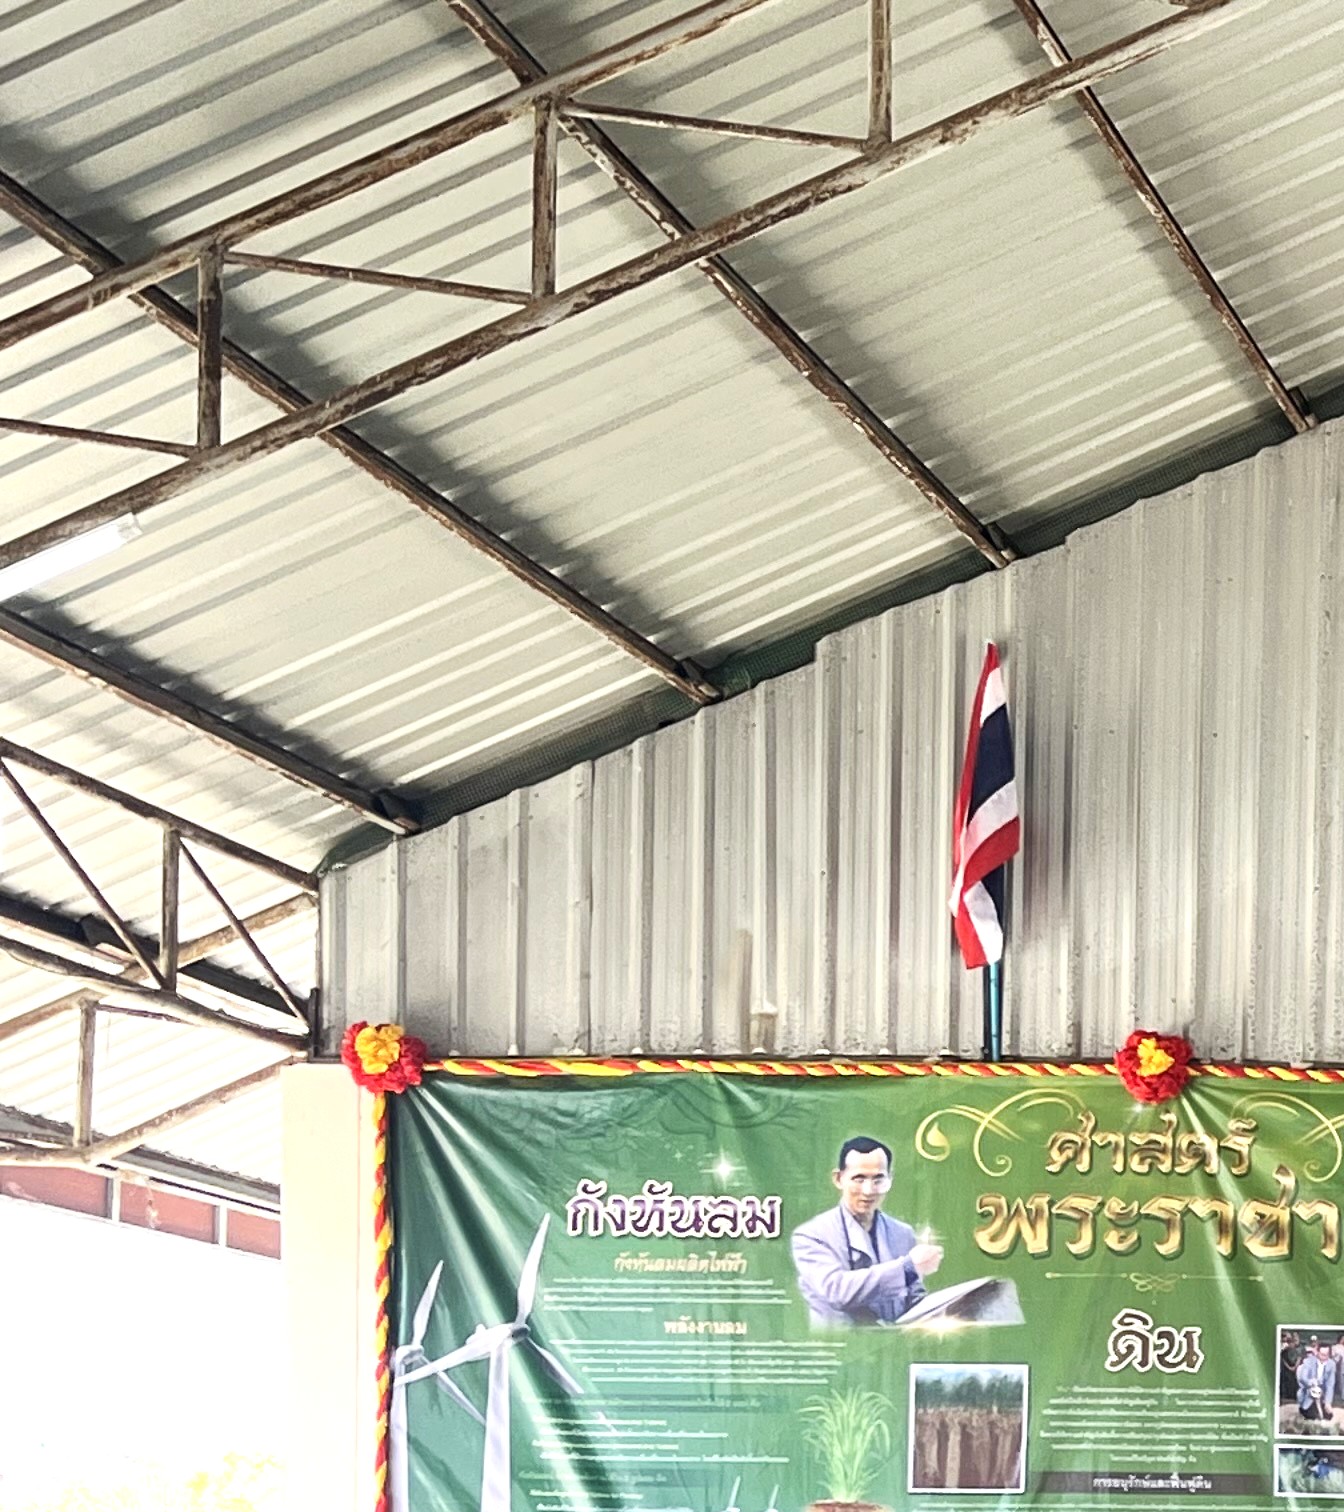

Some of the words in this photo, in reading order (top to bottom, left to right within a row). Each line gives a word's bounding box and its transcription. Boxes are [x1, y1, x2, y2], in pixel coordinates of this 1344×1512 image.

[1045, 1110, 1257, 1176] ศาสตร์
[566, 1178, 782, 1238] กังหันลม
[973, 1164, 1342, 1261] พระราชา
[1104, 1308, 1204, 1374] ดิน
